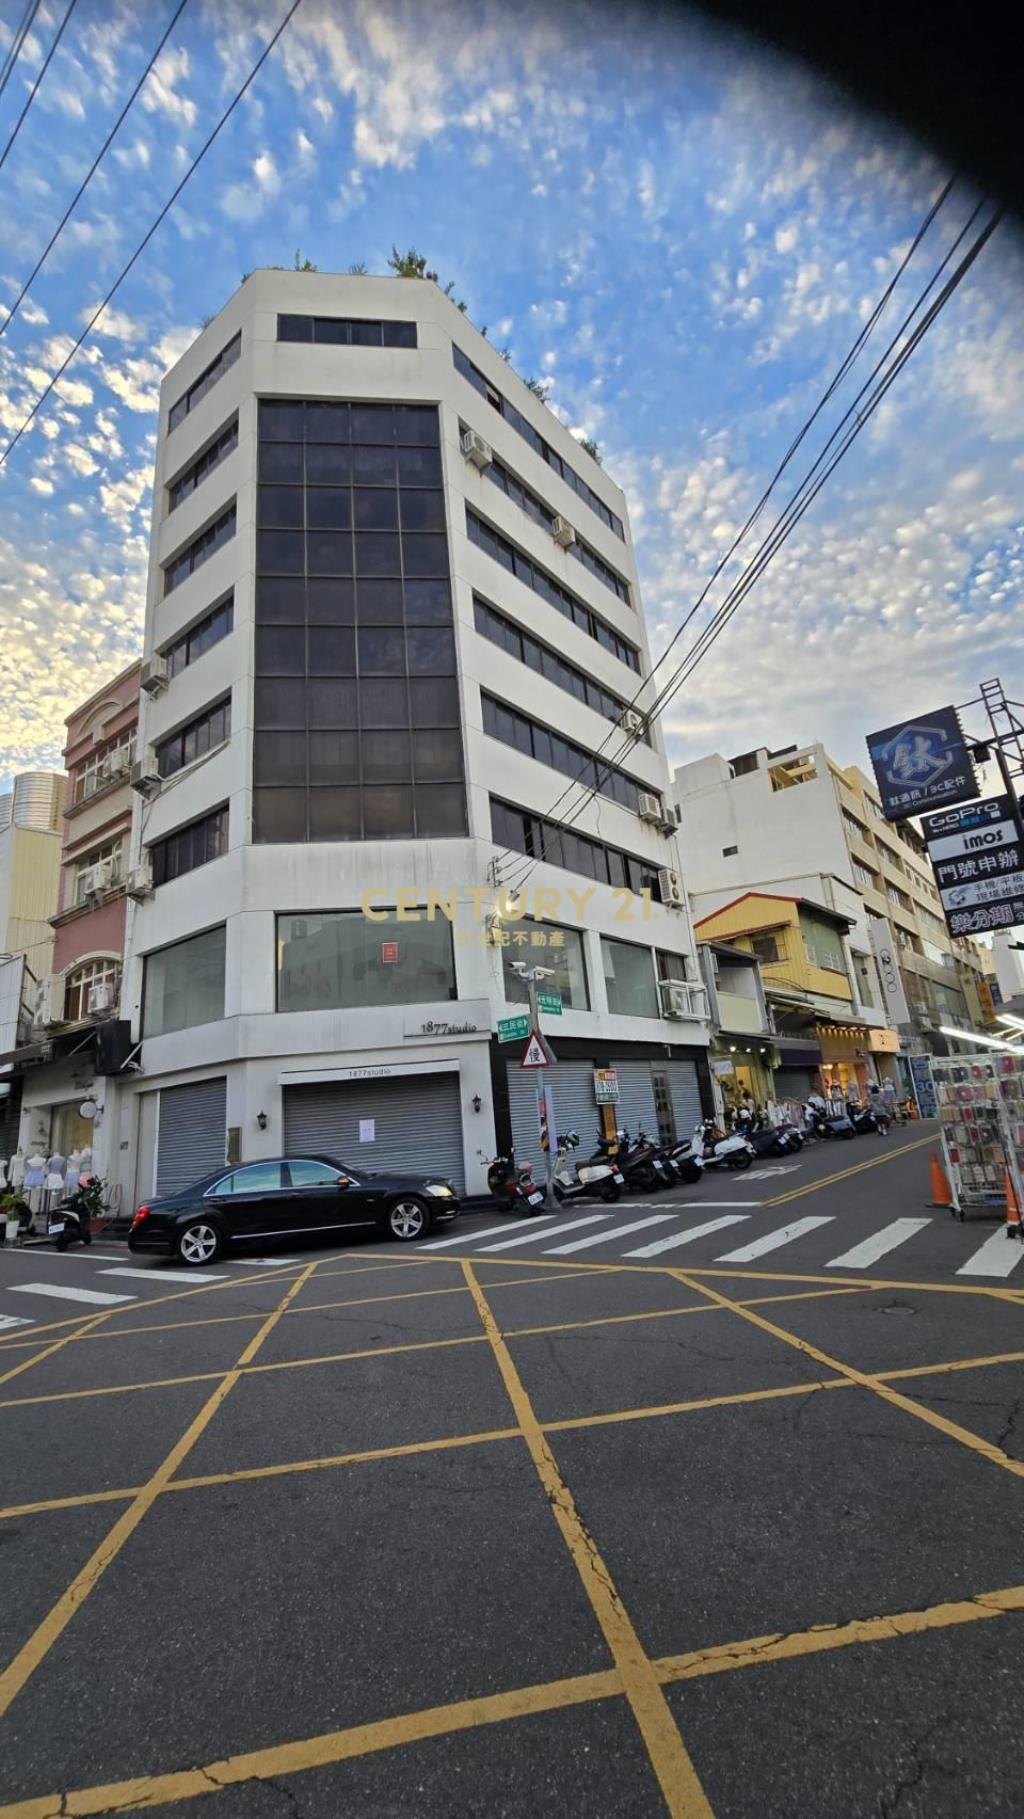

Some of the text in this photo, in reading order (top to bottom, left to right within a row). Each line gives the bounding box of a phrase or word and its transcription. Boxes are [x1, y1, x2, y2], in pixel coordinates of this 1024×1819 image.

[929, 802, 999, 828] GoPro
[963, 829, 1004, 850] imos
[937, 849, 1019, 884] 門號申辦
[951, 904, 1014, 934] 樂分期
[421, 1021, 477, 1035] 1877studio
[528, 1047, 541, 1063] 慢
[348, 1068, 392, 1079] 1877studio
